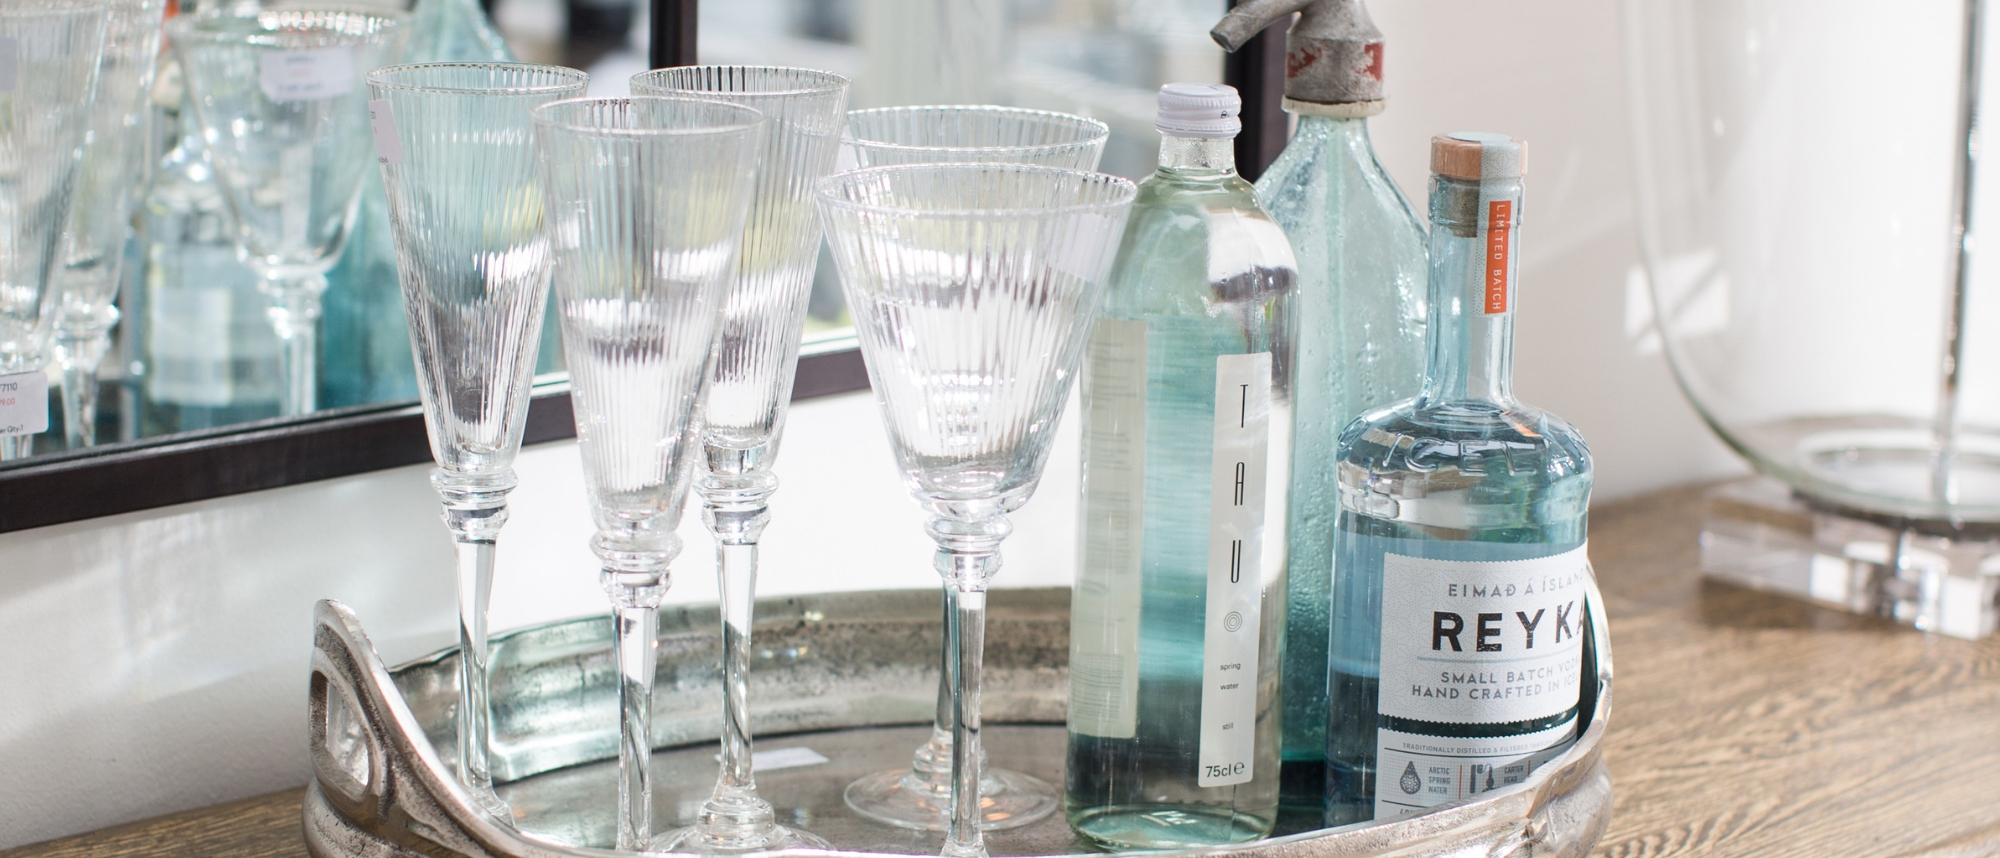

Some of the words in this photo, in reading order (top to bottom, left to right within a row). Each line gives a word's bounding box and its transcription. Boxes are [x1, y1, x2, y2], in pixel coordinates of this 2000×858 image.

[1494, 204, 1506, 260] LIMITED
[1492, 269, 1502, 310] BATCH
[0, 382, 18, 392] 7110
[1219, 662, 1241, 671] spring
[1440, 671, 1497, 684] SMALL
[1506, 666, 1553, 683] BATCH
[1412, 685, 1459, 699] HAND
[1469, 684, 1542, 700] CRAFTED
[1548, 679, 1559, 692] IN
[1222, 722, 1234, 731] still
[1403, 742, 1455, 753] TRADITIONALLY
[1500, 744, 1528, 753] FILTERED
[1428, 766, 1450, 775] ARCTIC
[1504, 764, 1524, 774] CARTER
[1428, 776, 1451, 785] SPRING
[1428, 786, 1447, 794] WATER
